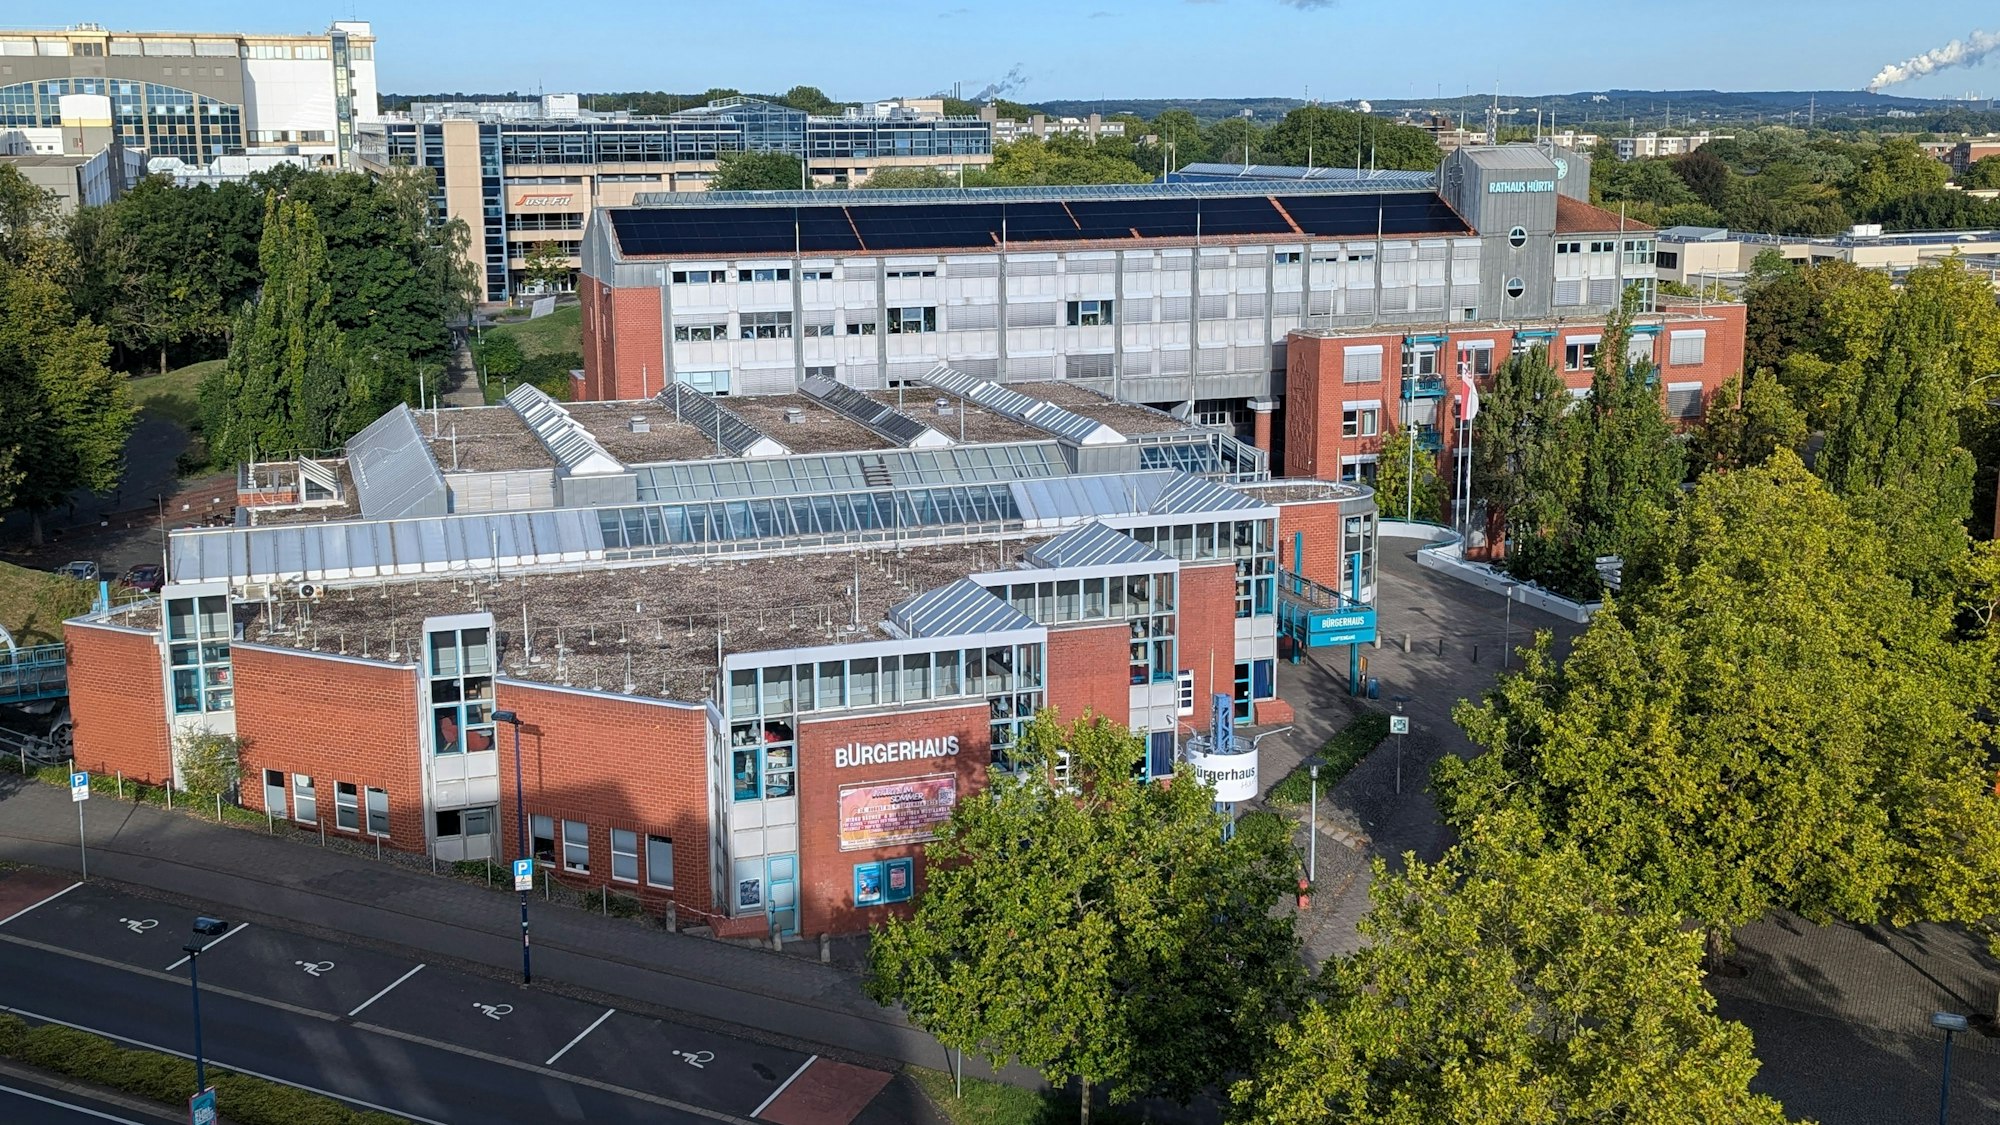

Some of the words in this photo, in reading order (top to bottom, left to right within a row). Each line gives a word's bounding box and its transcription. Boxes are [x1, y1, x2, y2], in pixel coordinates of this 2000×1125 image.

[1489, 181, 1525, 193] RATHAUS
[1527, 179, 1554, 192] HÜRTH
[515, 194, 548, 206] Just
[550, 196, 571, 206] Fit
[1321, 616, 1365, 629] BÜRGERHAUS
[1191, 763, 1256, 783] ürgerhaus
[75, 775, 84, 787] P
[518, 862, 528, 875] P
